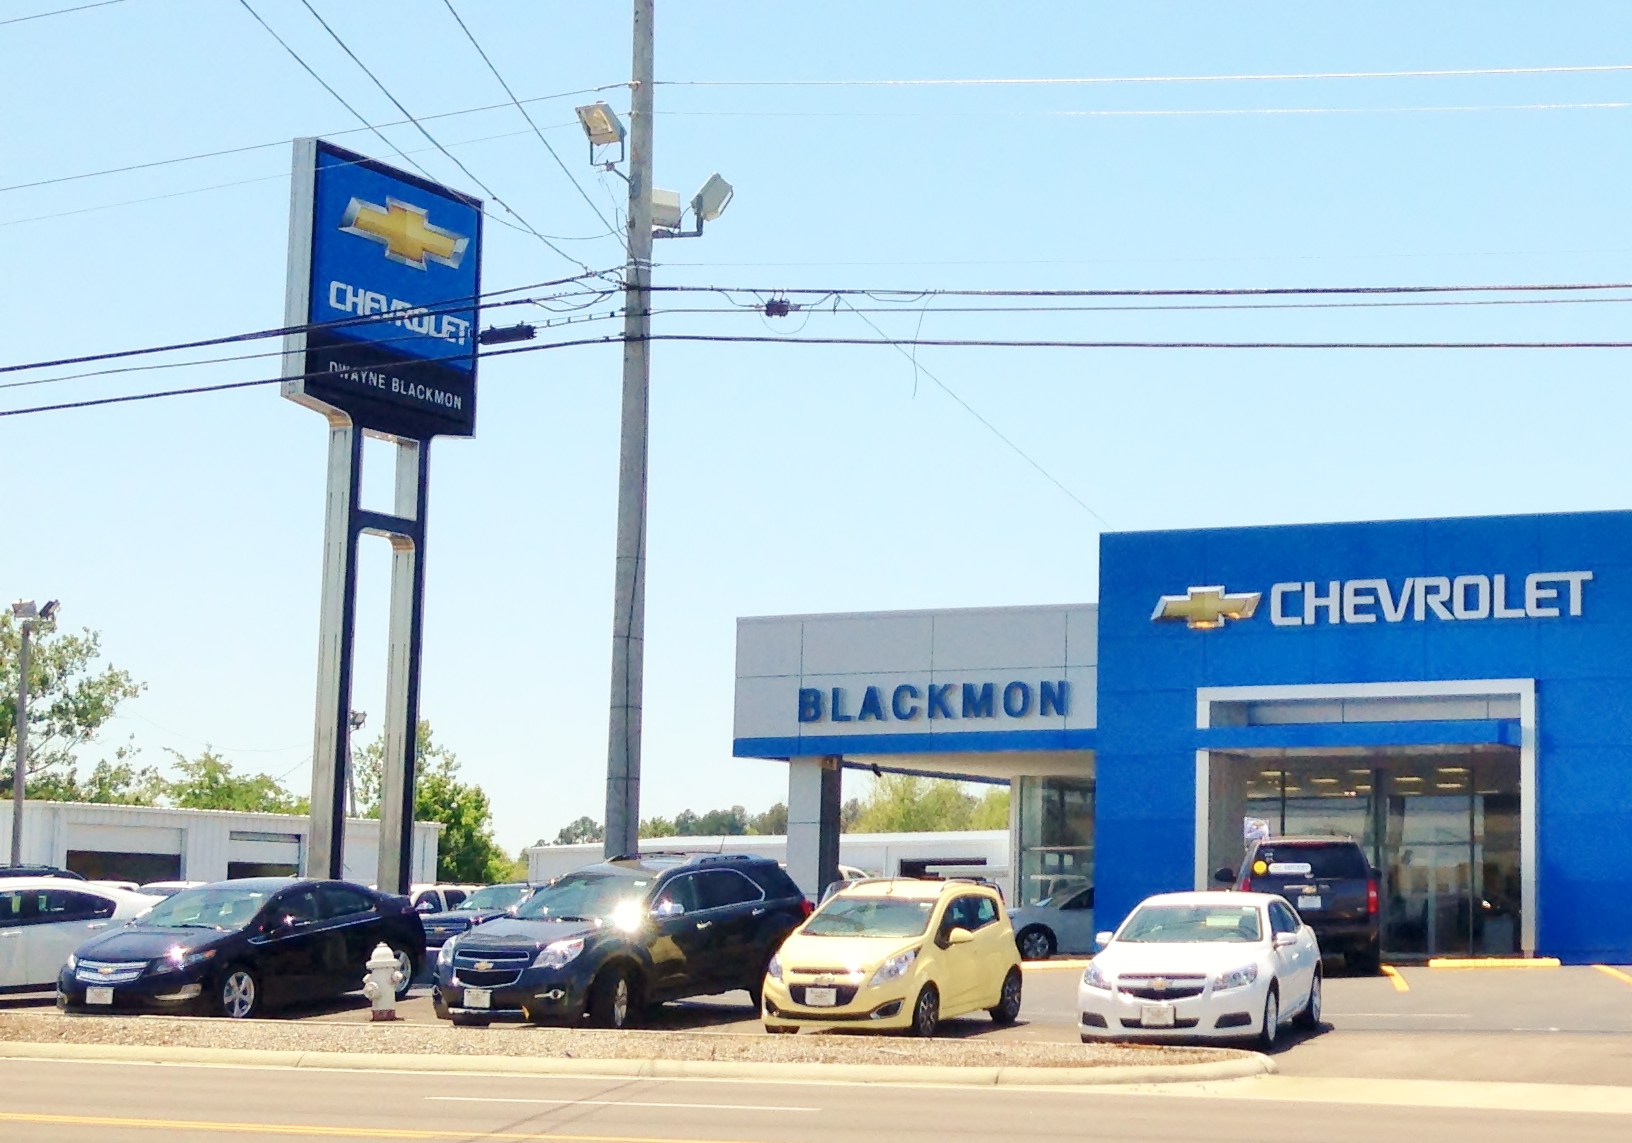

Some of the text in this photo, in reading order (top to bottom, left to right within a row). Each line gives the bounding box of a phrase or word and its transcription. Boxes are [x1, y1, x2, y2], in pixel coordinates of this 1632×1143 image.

[329, 281, 470, 346] CHEVROLET
[391, 377, 462, 410] BLACKMON
[1271, 571, 1593, 626] CHEVROLET
[798, 681, 1069, 723] BLACKMON
